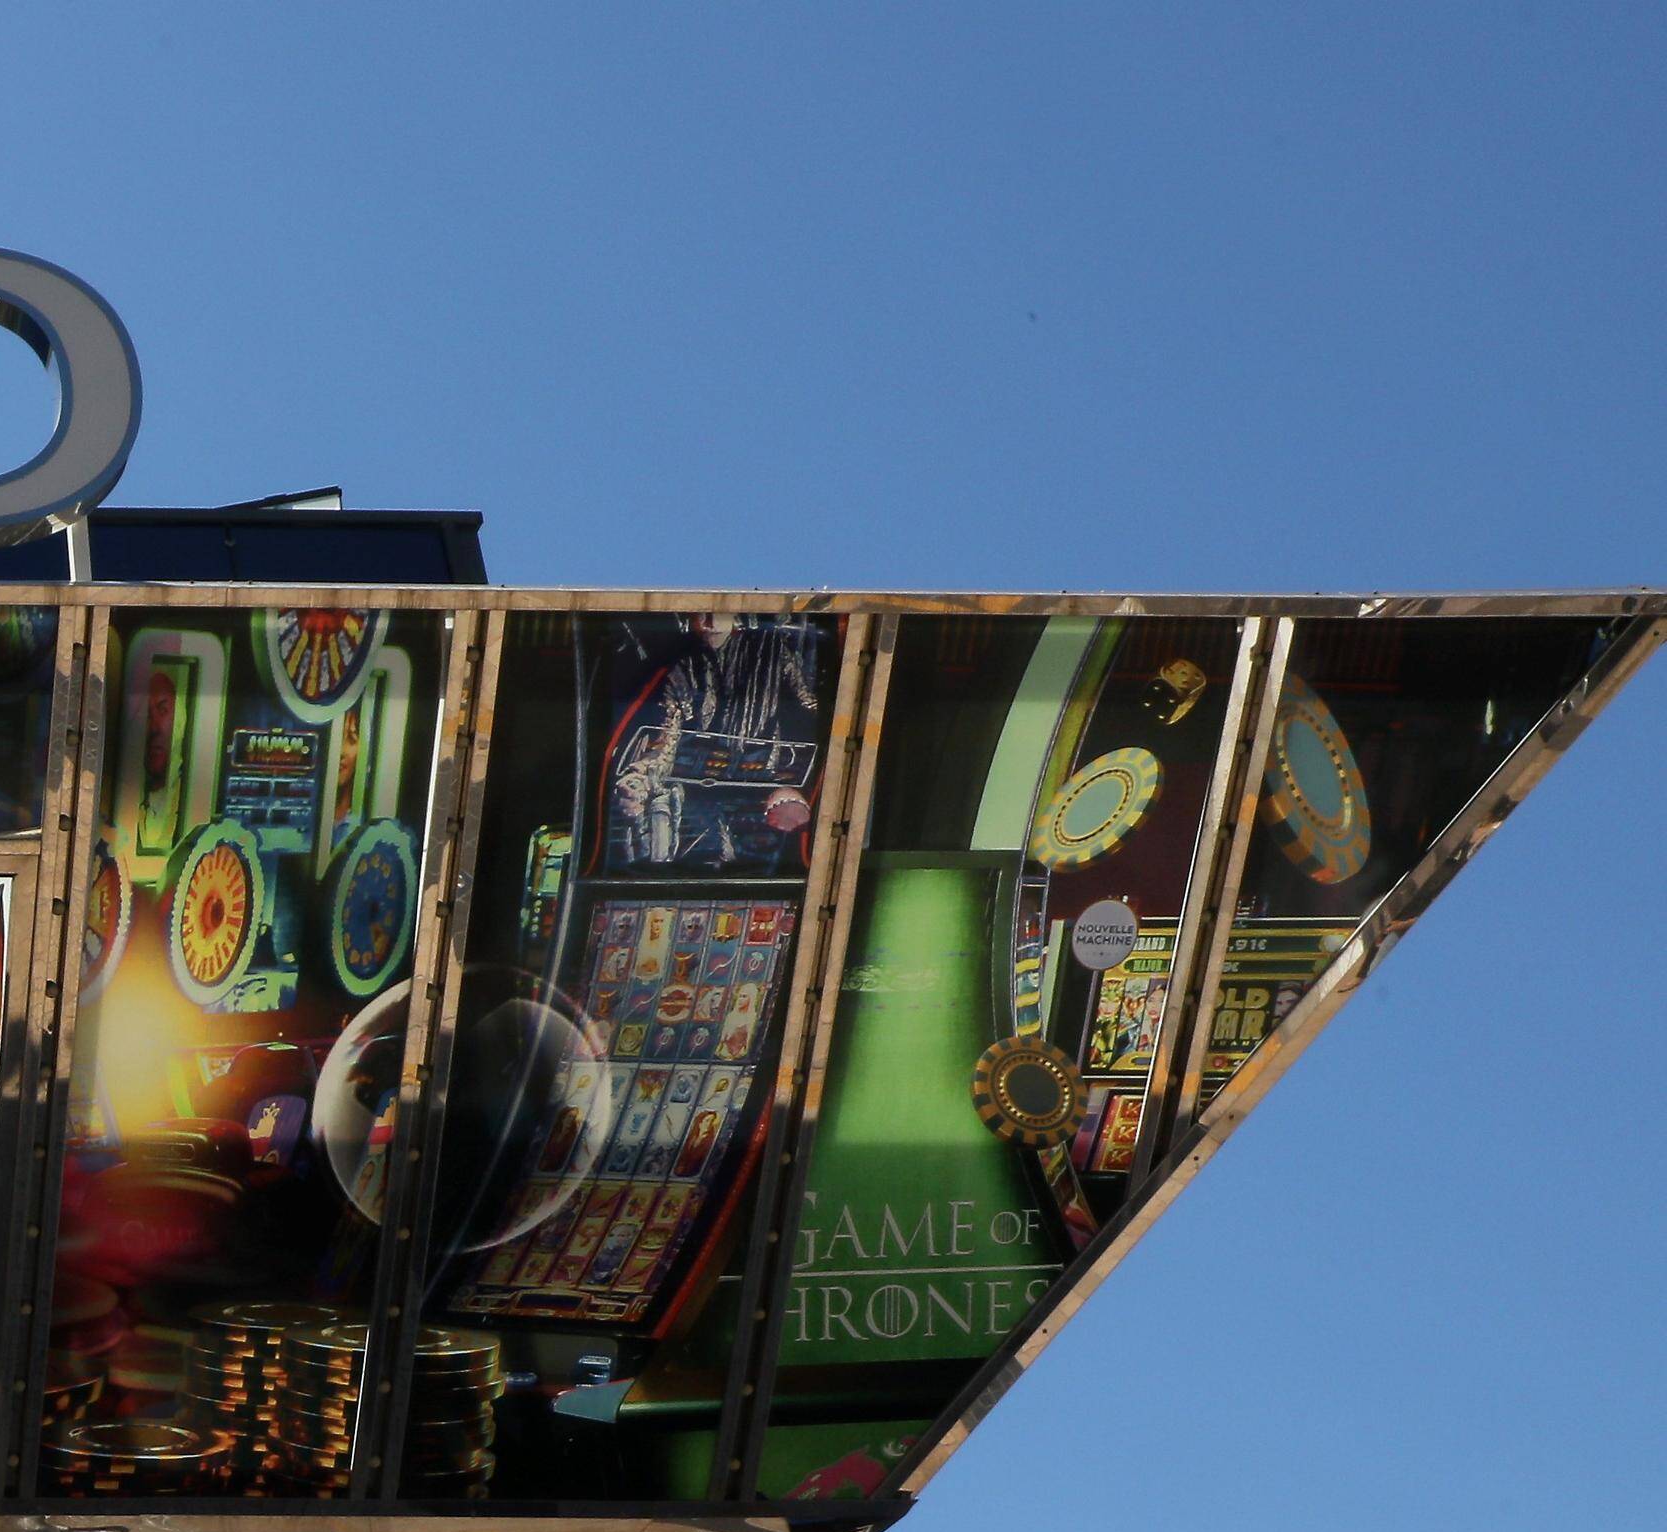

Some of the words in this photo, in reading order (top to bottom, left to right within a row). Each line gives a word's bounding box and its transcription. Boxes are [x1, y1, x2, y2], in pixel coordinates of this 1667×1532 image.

[1078, 924, 1135, 936] NOUVELLE
[1075, 934, 1133, 947] MACHINE
[989, 1209, 1042, 1245] OF
